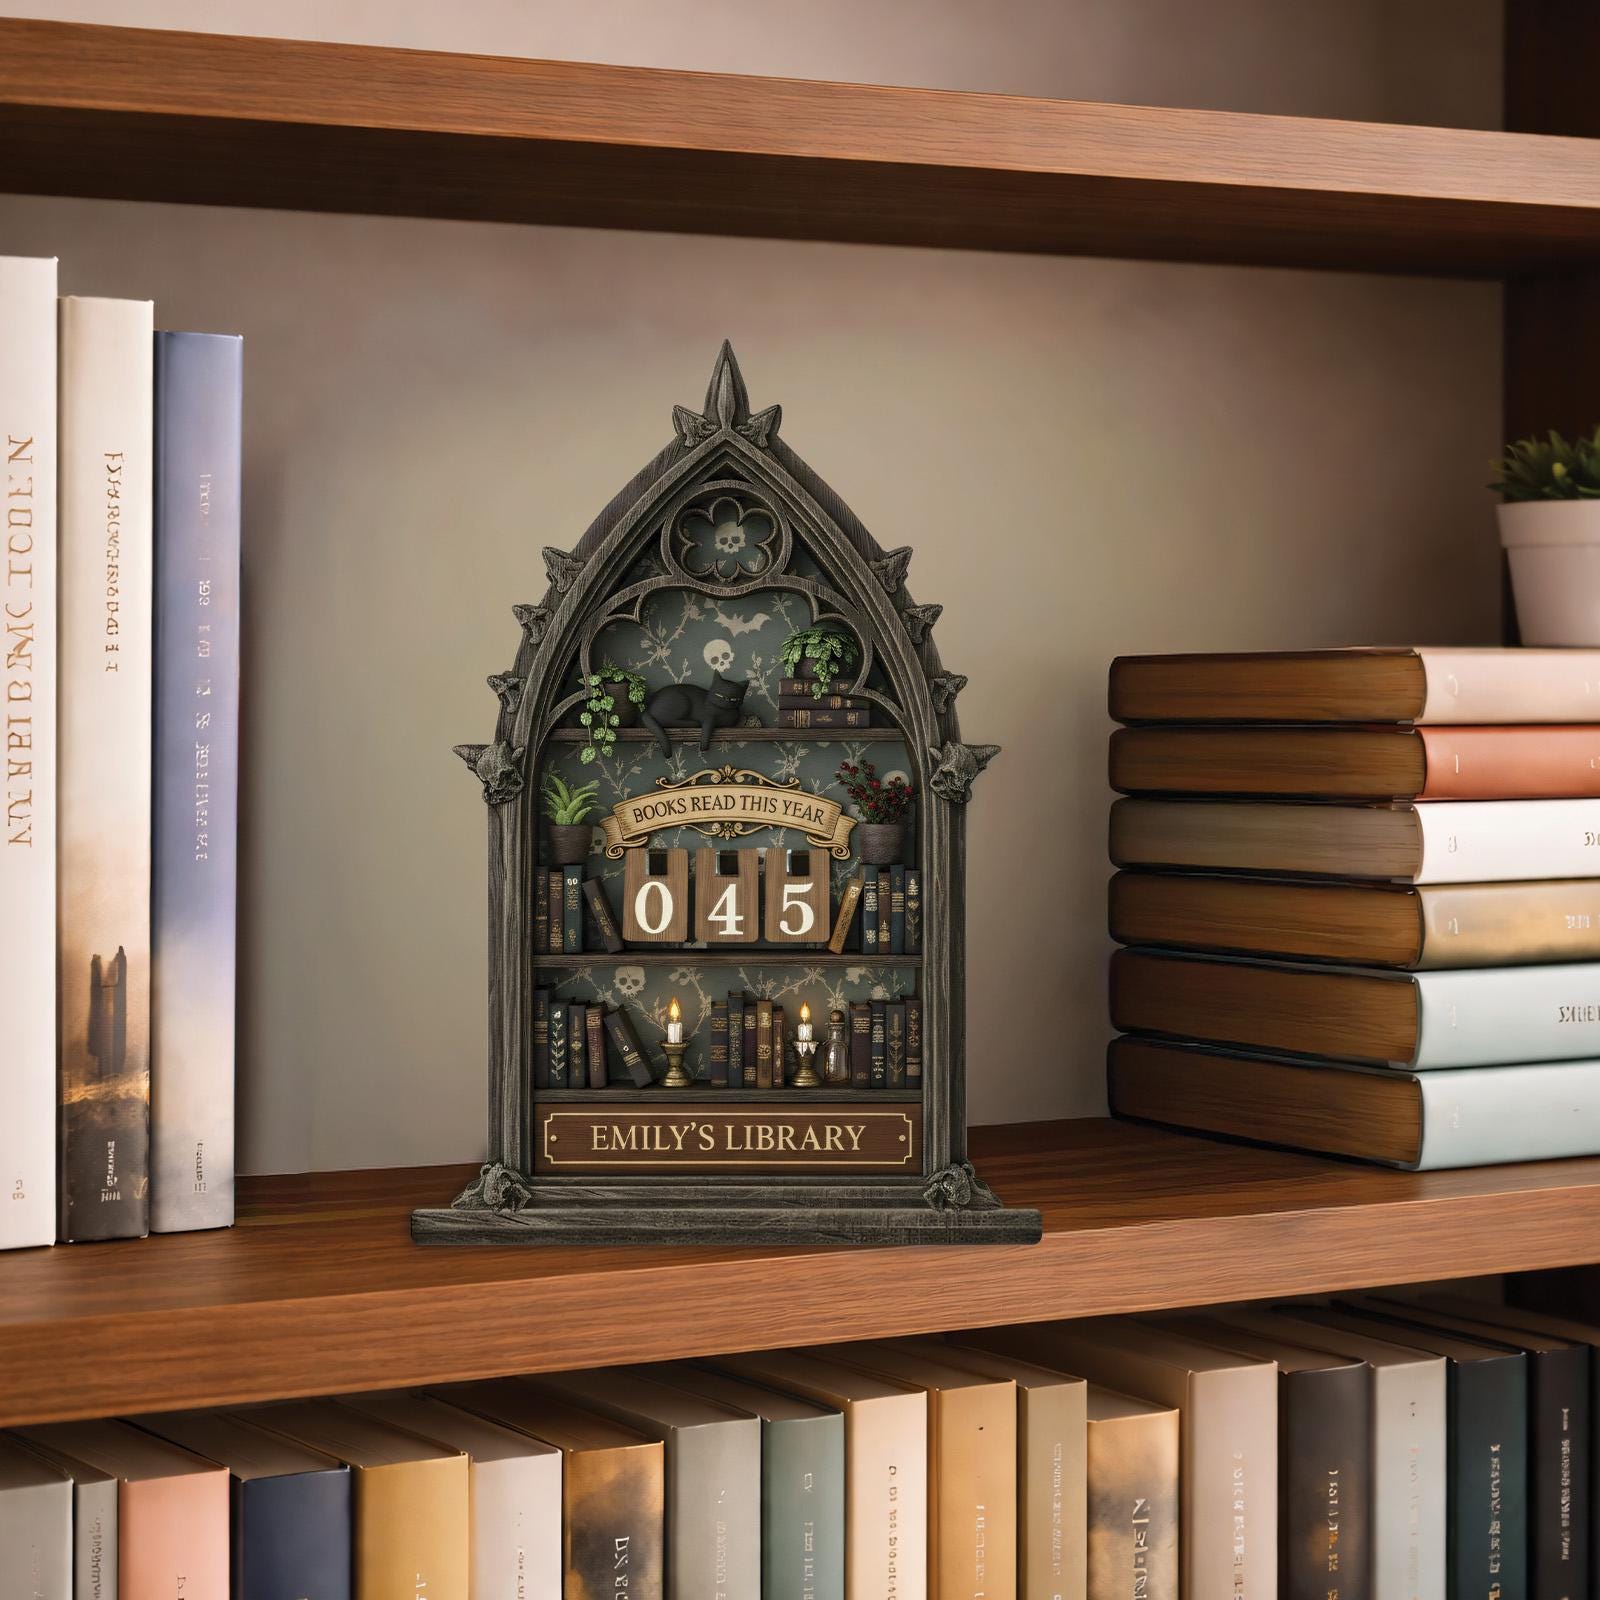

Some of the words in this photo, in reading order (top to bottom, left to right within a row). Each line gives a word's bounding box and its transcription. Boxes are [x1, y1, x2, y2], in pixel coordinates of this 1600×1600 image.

[633, 798, 687, 824] BOOKS
[691, 795, 736, 812] READ
[740, 795, 777, 813] THIS
[782, 800, 825, 825] YEAR
[590, 1122, 715, 1151] EMILY'S
[725, 1125, 866, 1151] LIBRARY
